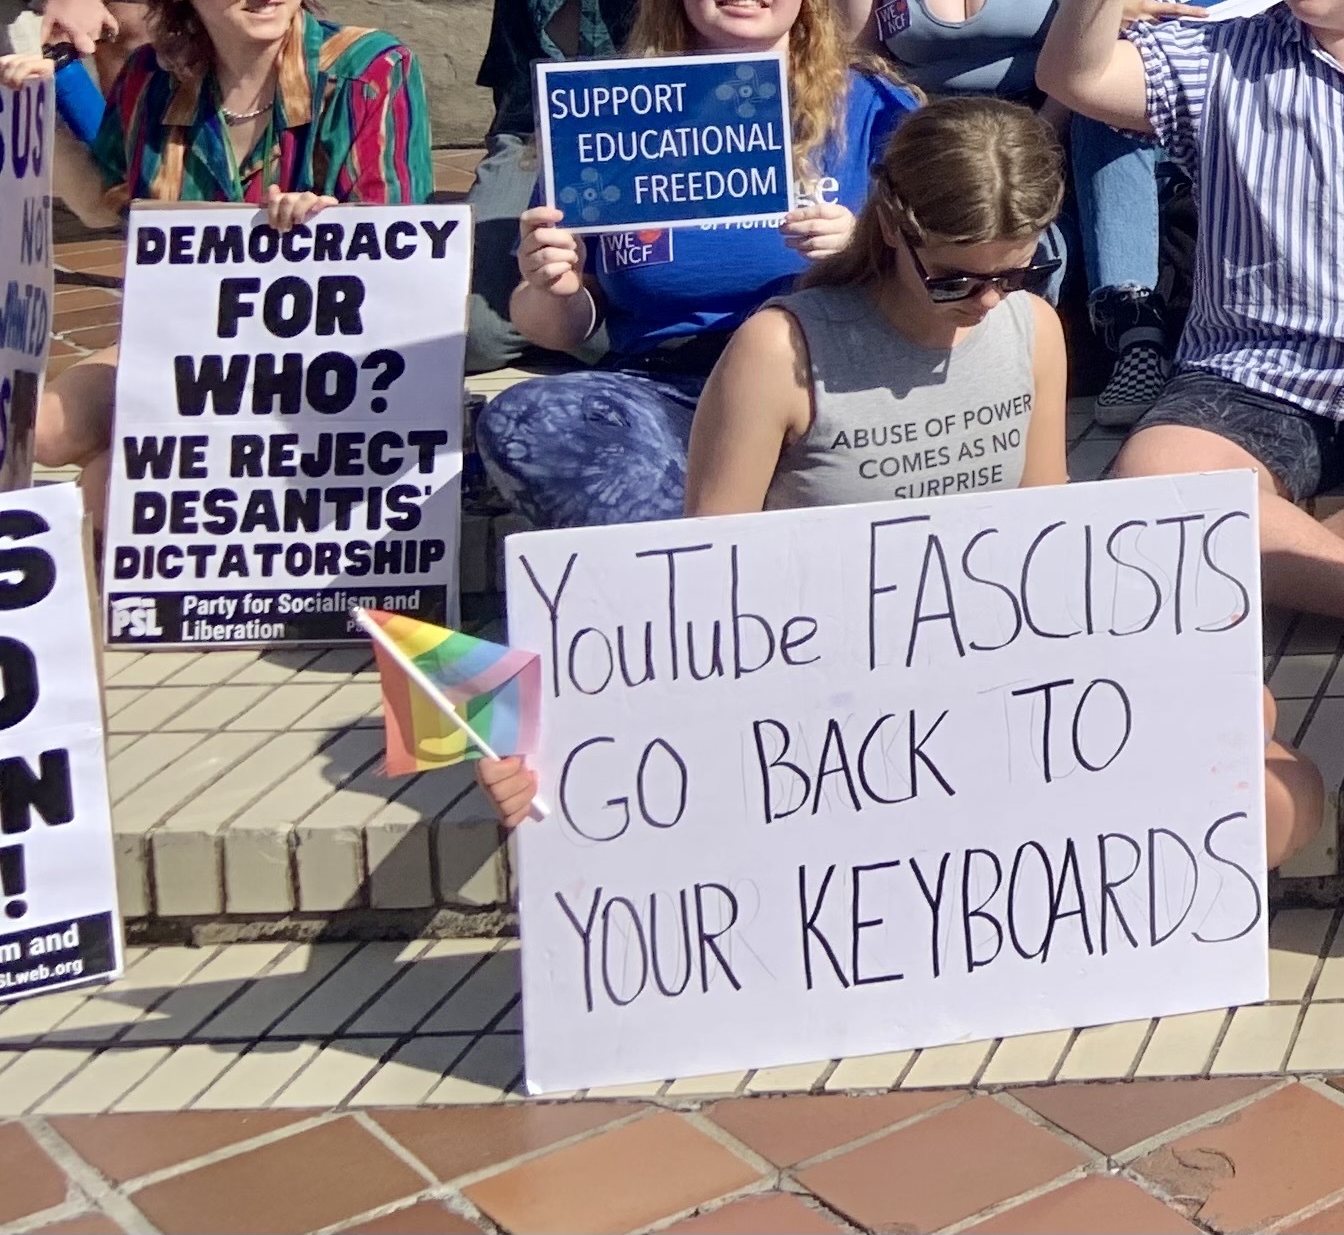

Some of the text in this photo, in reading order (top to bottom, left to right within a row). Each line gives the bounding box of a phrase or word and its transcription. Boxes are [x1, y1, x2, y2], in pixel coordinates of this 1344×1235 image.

[551, 82, 687, 120] SUPPORT
[577, 123, 783, 164] EDUCATIONAL
[633, 167, 778, 205] FREEDOM
[135, 219, 460, 267] DEMOCRACY
[607, 231, 634, 250] WE
[616, 244, 652, 266] NCF
[216, 274, 366, 340] FOR
[172, 349, 407, 417] WHO?
[829, 391, 1034, 452] ABUSE OF POWER
[123, 428, 450, 482] WE REJECT
[857, 427, 1022, 482] COMES AS NO
[893, 463, 1005, 500] SURPRISE
[131, 483, 433, 537] DESANTIS'
[113, 538, 447, 582] DICTATORSHIP
[183, 589, 421, 620] Party for Socialism and
[867, 510, 1254, 672] FASCISTS
[181, 619, 286, 642] Liberation
[558, 677, 1134, 843] GO BACK TO
[553, 811, 1265, 1014] YOUR KEYBOARDS
